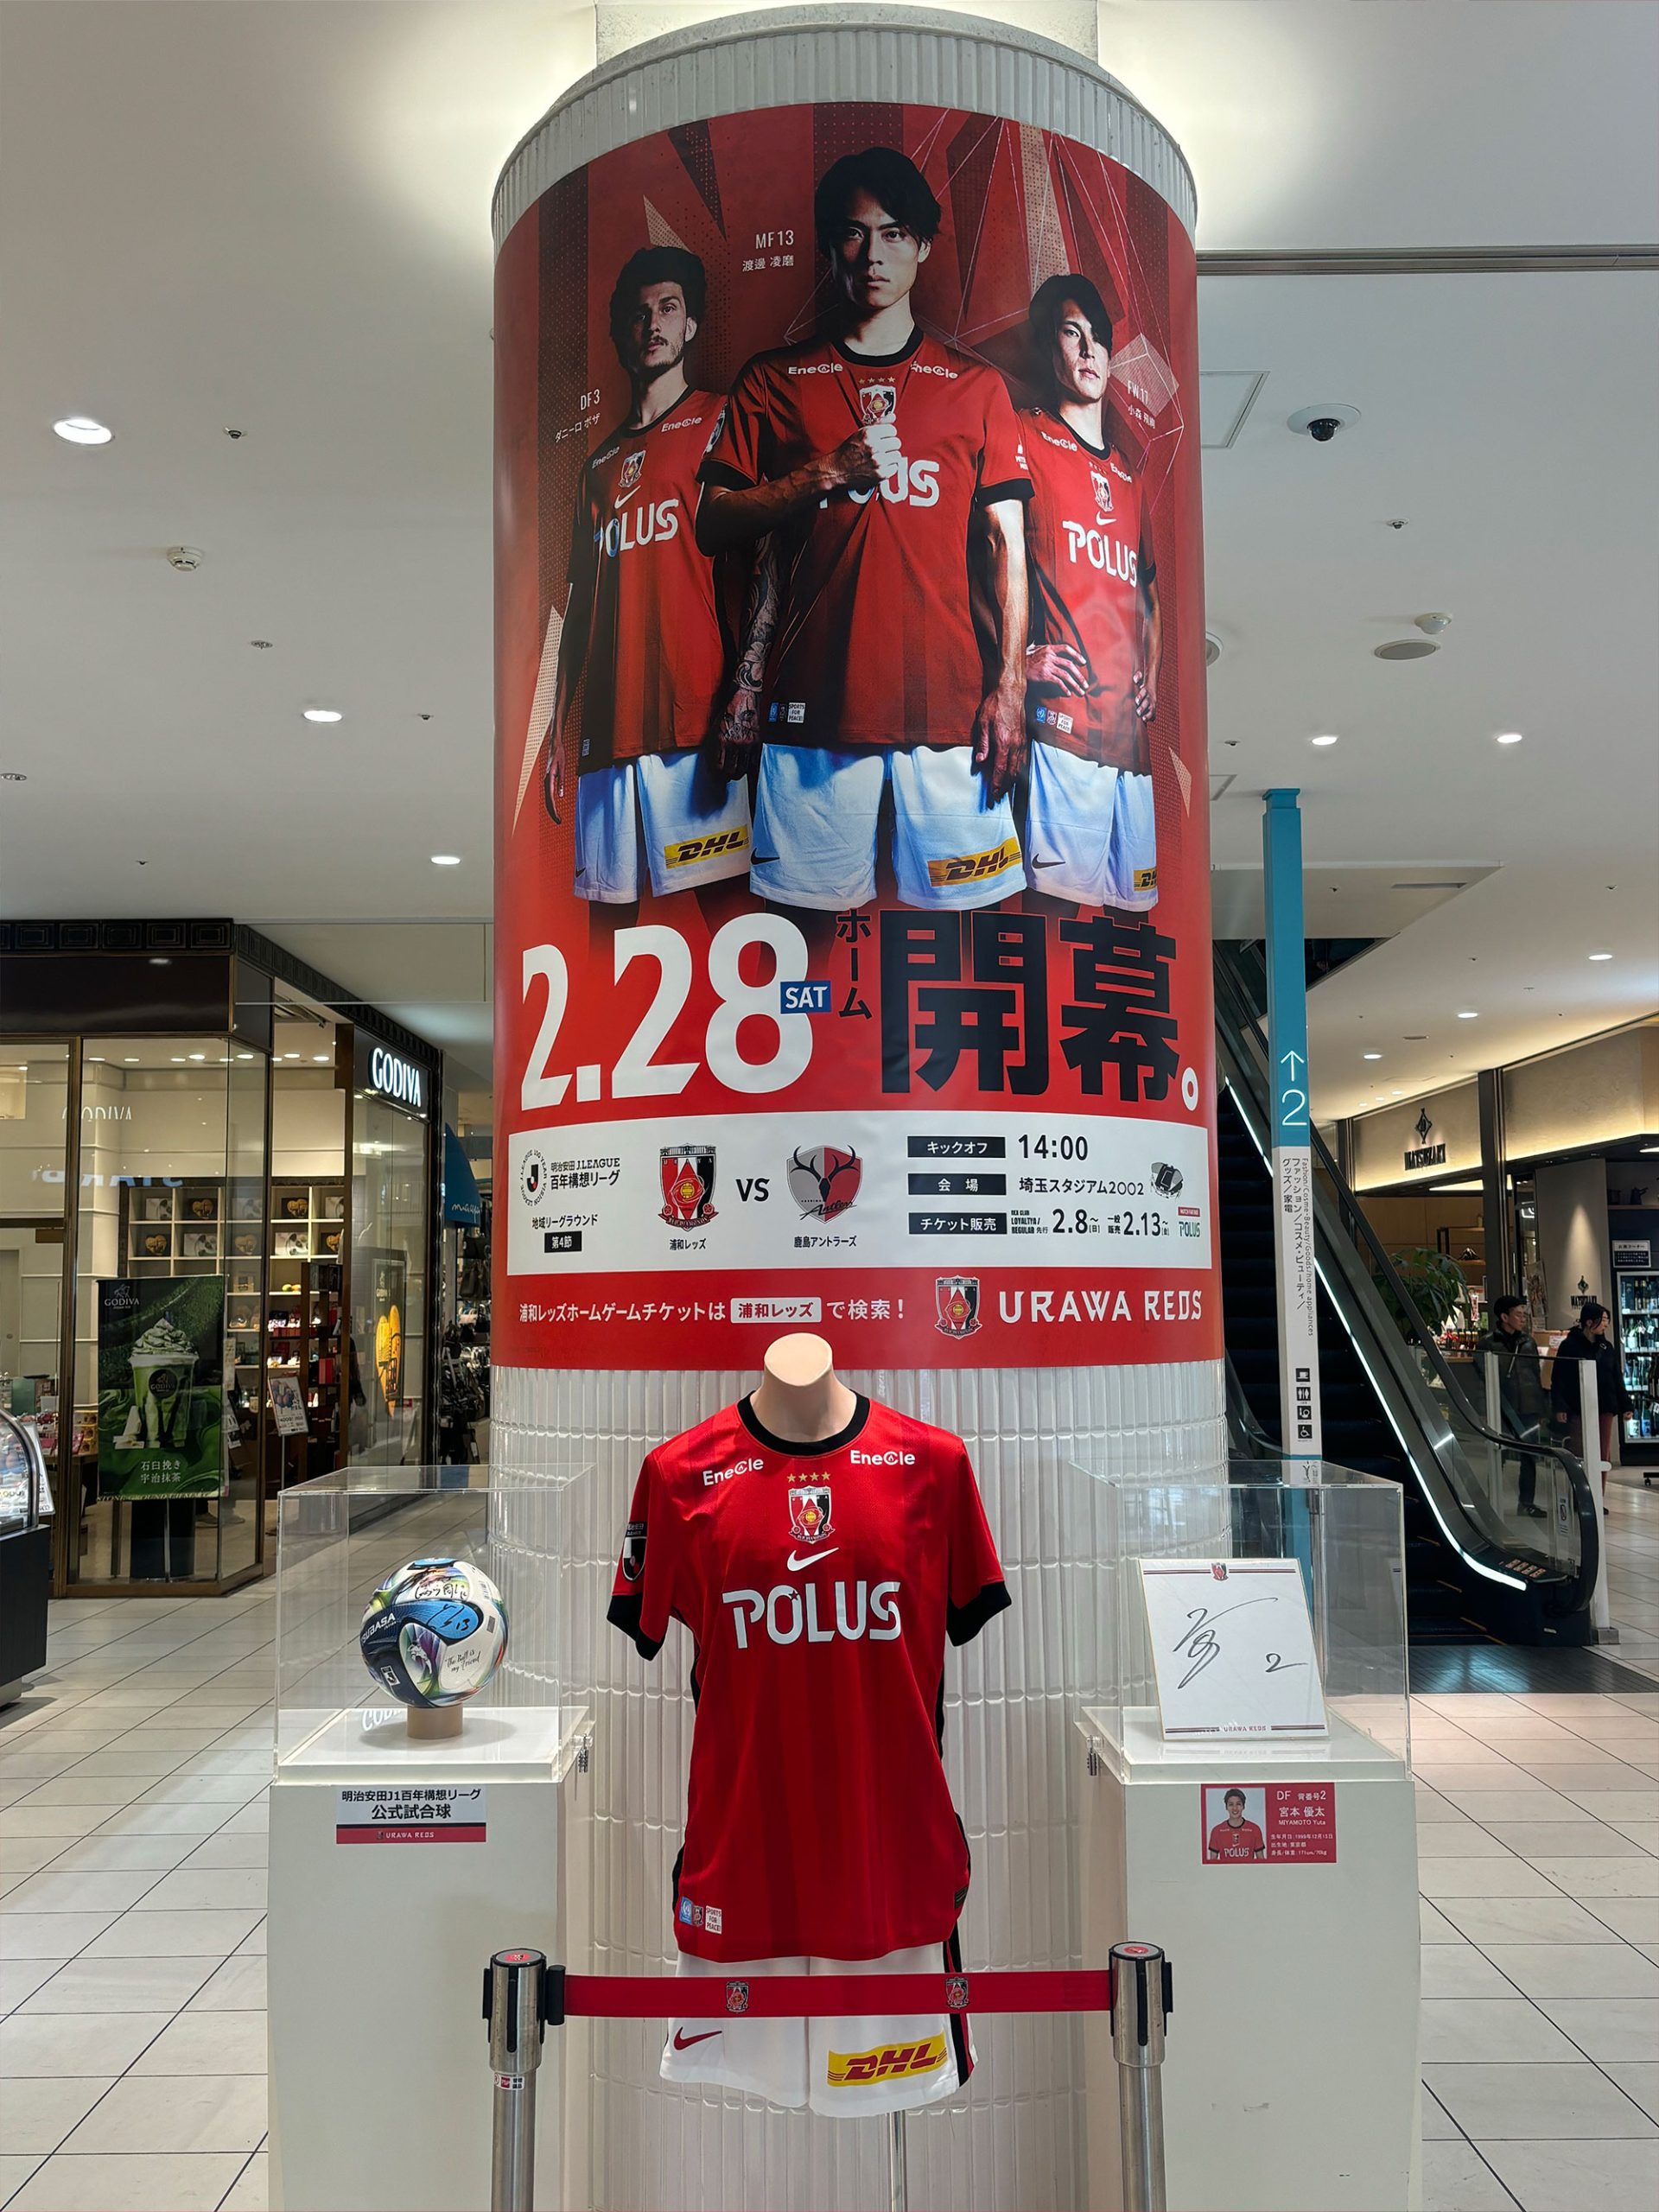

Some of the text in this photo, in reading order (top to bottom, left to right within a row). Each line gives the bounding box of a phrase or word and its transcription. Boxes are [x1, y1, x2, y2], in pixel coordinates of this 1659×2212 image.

[555, 422, 582, 442] ダニーロ
[1062, 520, 1137, 588] POLUS
[677, 831, 745, 859] DHL
[945, 847, 1012, 879] DHL
[836, 909, 872, 1020] ホーム
[785, 986, 827, 1009] SAT
[521, 912, 813, 1111] 2.28
[372, 1047, 421, 1107] GODIVA
[1282, 1090, 1306, 1126] 2
[927, 1141, 988, 1154] キックオフ
[1018, 1134, 1088, 1160] 14:00
[550, 1158, 620, 1173] 明治安田 J.LEAGUE
[550, 1169, 620, 1190] 百年構想リーグ
[1019, 1177, 1144, 1196] 埼玉スタジアム2002
[735, 1178, 770, 1202] VS
[531, 1214, 598, 1230] 地域リーグラウンド
[920, 1218, 997, 1232] チケット販売
[1107, 1215, 1121, 1224] 一般
[1123, 1211, 1160, 1236] 2.13
[1108, 1224, 1121, 1234] 販売
[1179, 1221, 1200, 1237] POLUS
[551, 1236, 572, 1249] 第4節
[670, 1238, 706, 1250] 浦和レッズ
[794, 1235, 857, 1249] 鹿島アントラーズ
[105, 1298, 140, 1307] GODIVA
[999, 1289, 1202, 1324] URAWA REDS
[519, 1301, 726, 1323] 浦和レッズホームゲームチケットは
[739, 1302, 813, 1319] 浦和レッズ
[140, 1472, 181, 1484] 宇治抹茶
[722, 1580, 902, 1649] POLUS
[341, 1788, 481, 1802] 明治安田J1百年構想リーグ
[1276, 1789, 1326, 1801] DF 背番号2
[372, 1803, 452, 1820] 公式試合球
[1279, 1806, 1325, 1818] 宮本 優太
[1224, 1847, 1249, 1858] POLUS
[706, 1907, 721, 1917] SPORTS
[709, 1915, 718, 1923] FOR
[844, 2043, 938, 2081] DHL
